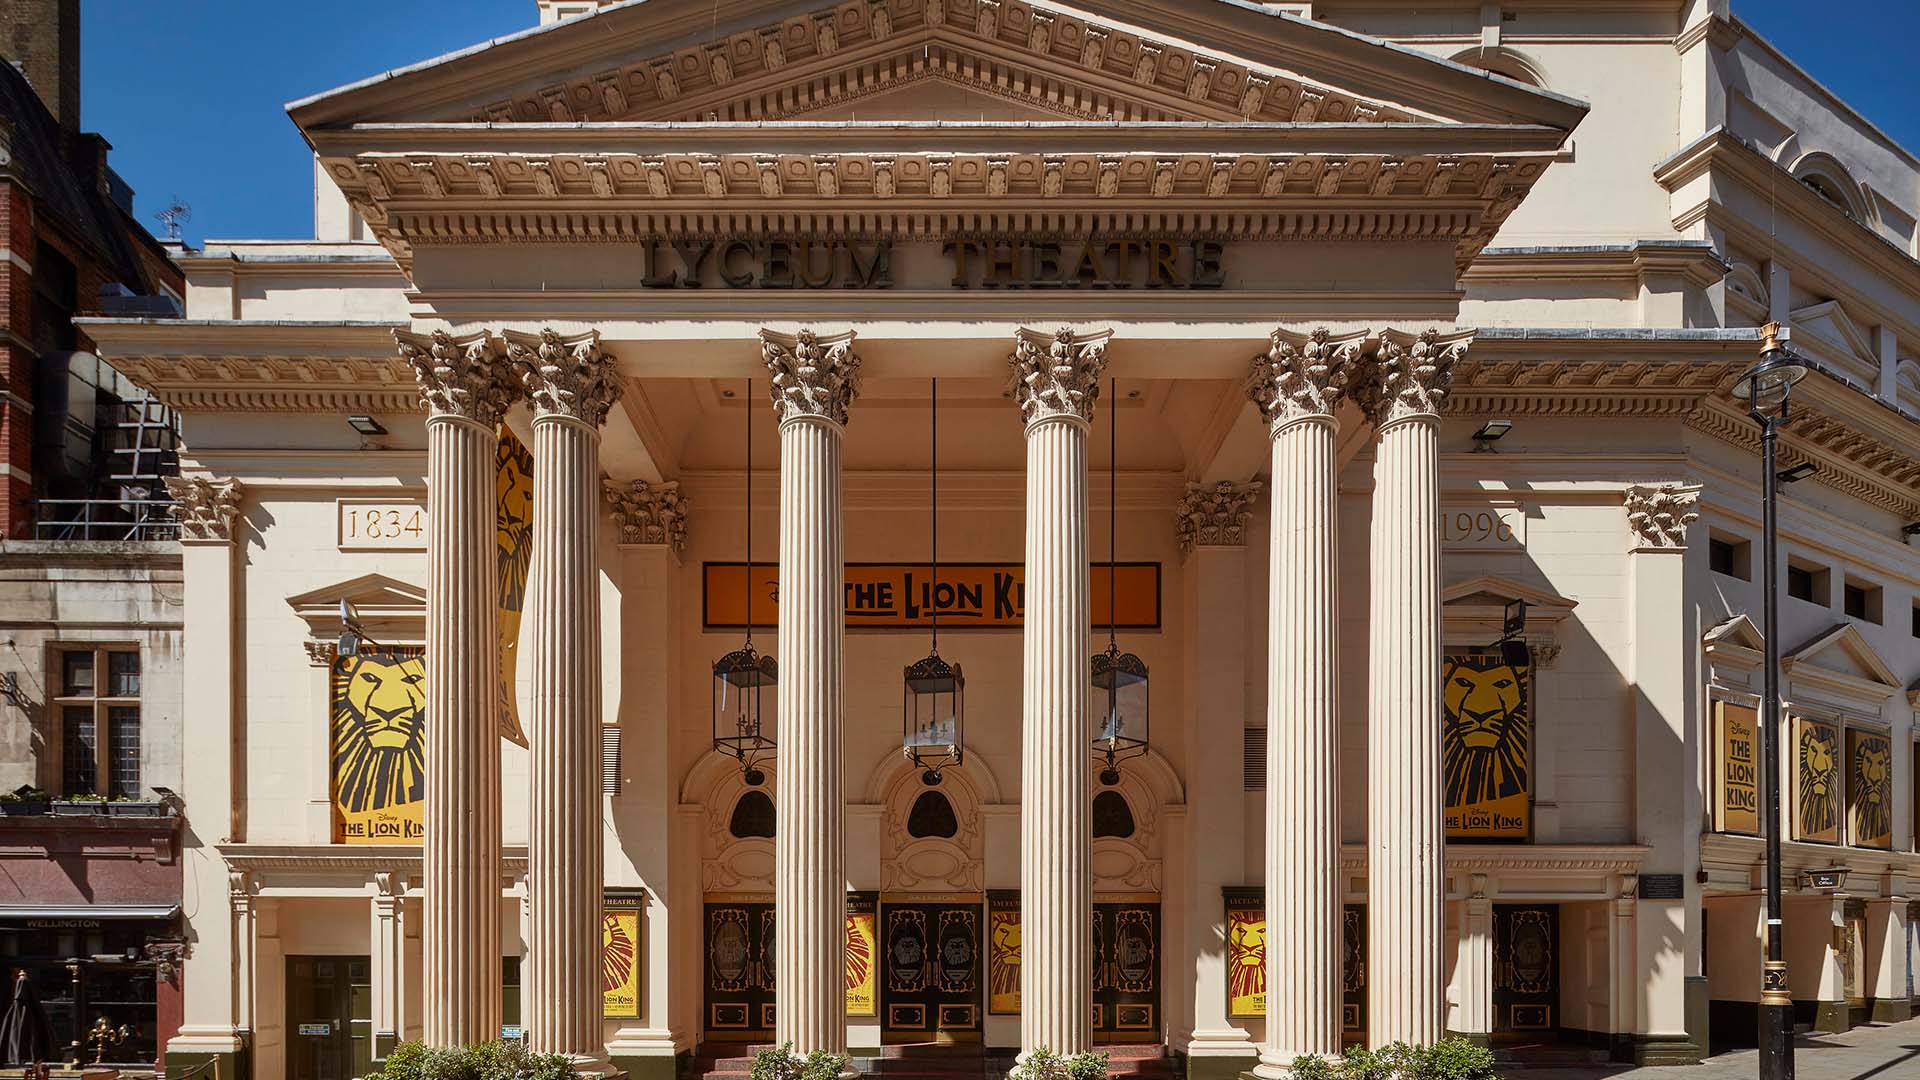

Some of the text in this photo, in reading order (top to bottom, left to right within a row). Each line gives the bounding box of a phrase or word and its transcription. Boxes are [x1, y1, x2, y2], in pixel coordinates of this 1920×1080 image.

[640, 239, 1225, 288] LYCEUM THEATRE
[349, 510, 423, 538] 1834
[1441, 512, 1512, 542] 1996
[844, 572, 1025, 619] THE LION KI
[1729, 720, 1750, 739] Disney
[1730, 739, 1750, 759] THE
[1727, 762, 1754, 783] LION
[1727, 788, 1755, 808] KING
[377, 812, 398, 822] Disney
[1446, 813, 1523, 830] HE LION KING
[340, 823, 364, 835] THE
[368, 820, 400, 838] LION
[26, 920, 100, 928] WELLINGTON
